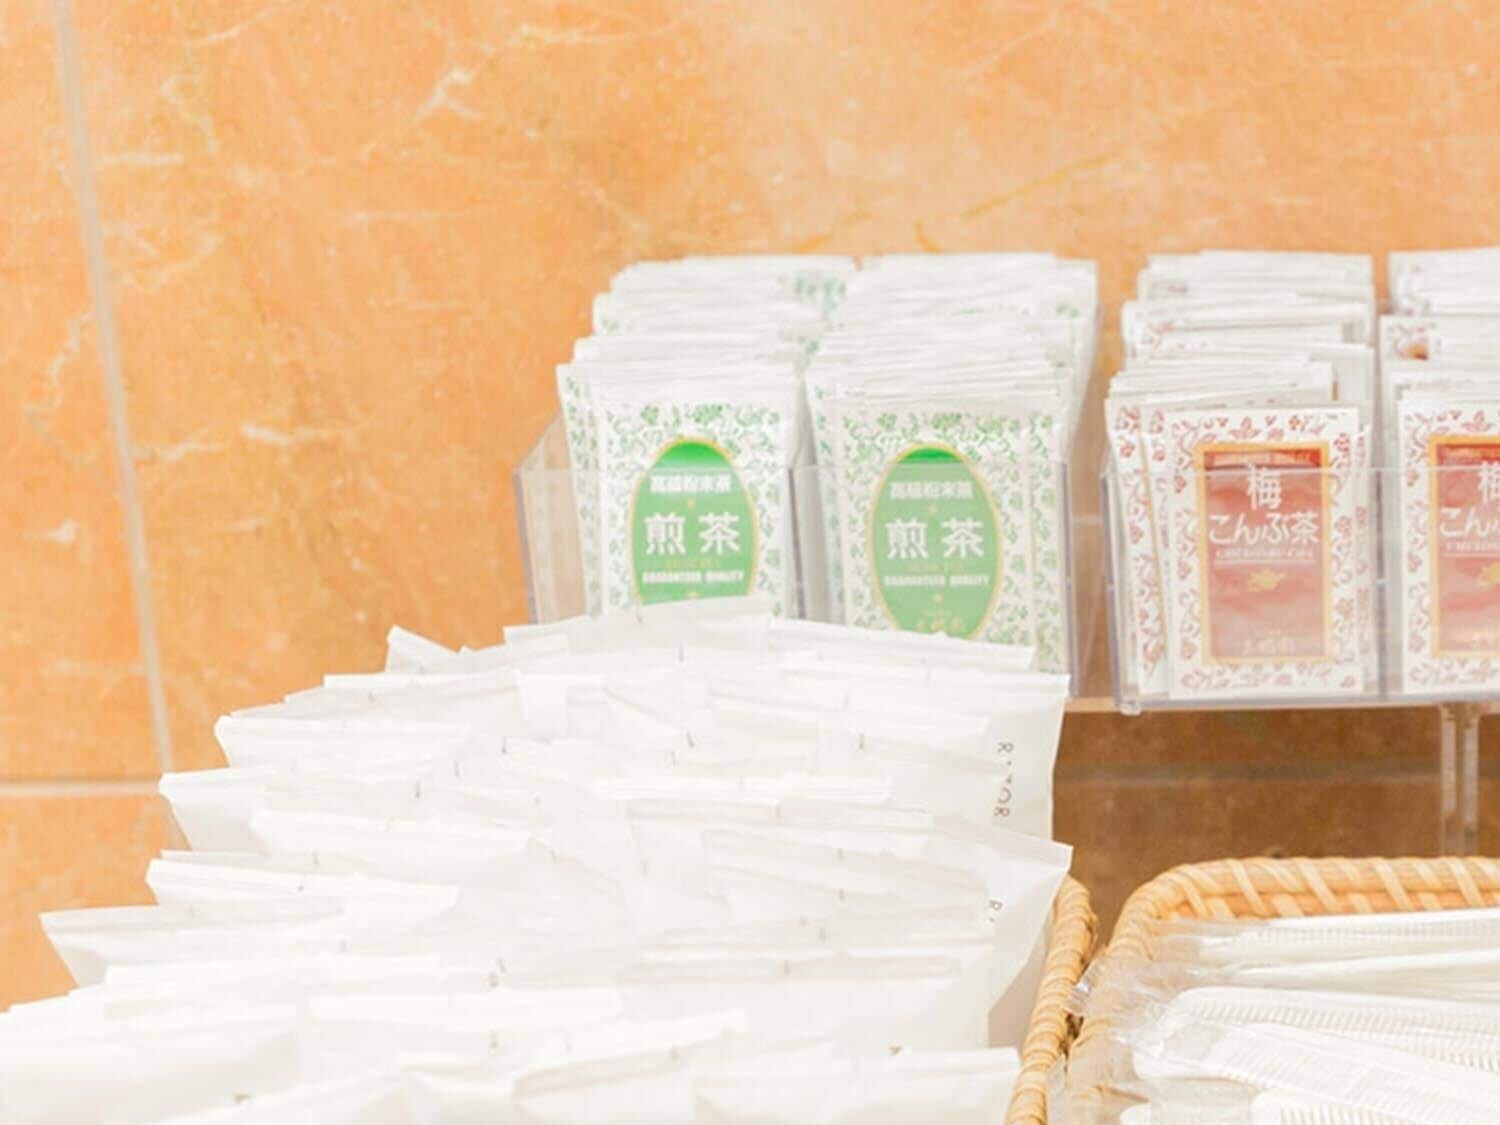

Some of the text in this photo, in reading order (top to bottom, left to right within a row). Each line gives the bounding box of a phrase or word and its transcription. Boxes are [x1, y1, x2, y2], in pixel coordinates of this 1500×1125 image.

[1246, 462, 1282, 511] 梅
[644, 511, 741, 555] 煎茶
[885, 517, 985, 559] 煎茶
[1208, 511, 1320, 545] こんぶ茶
